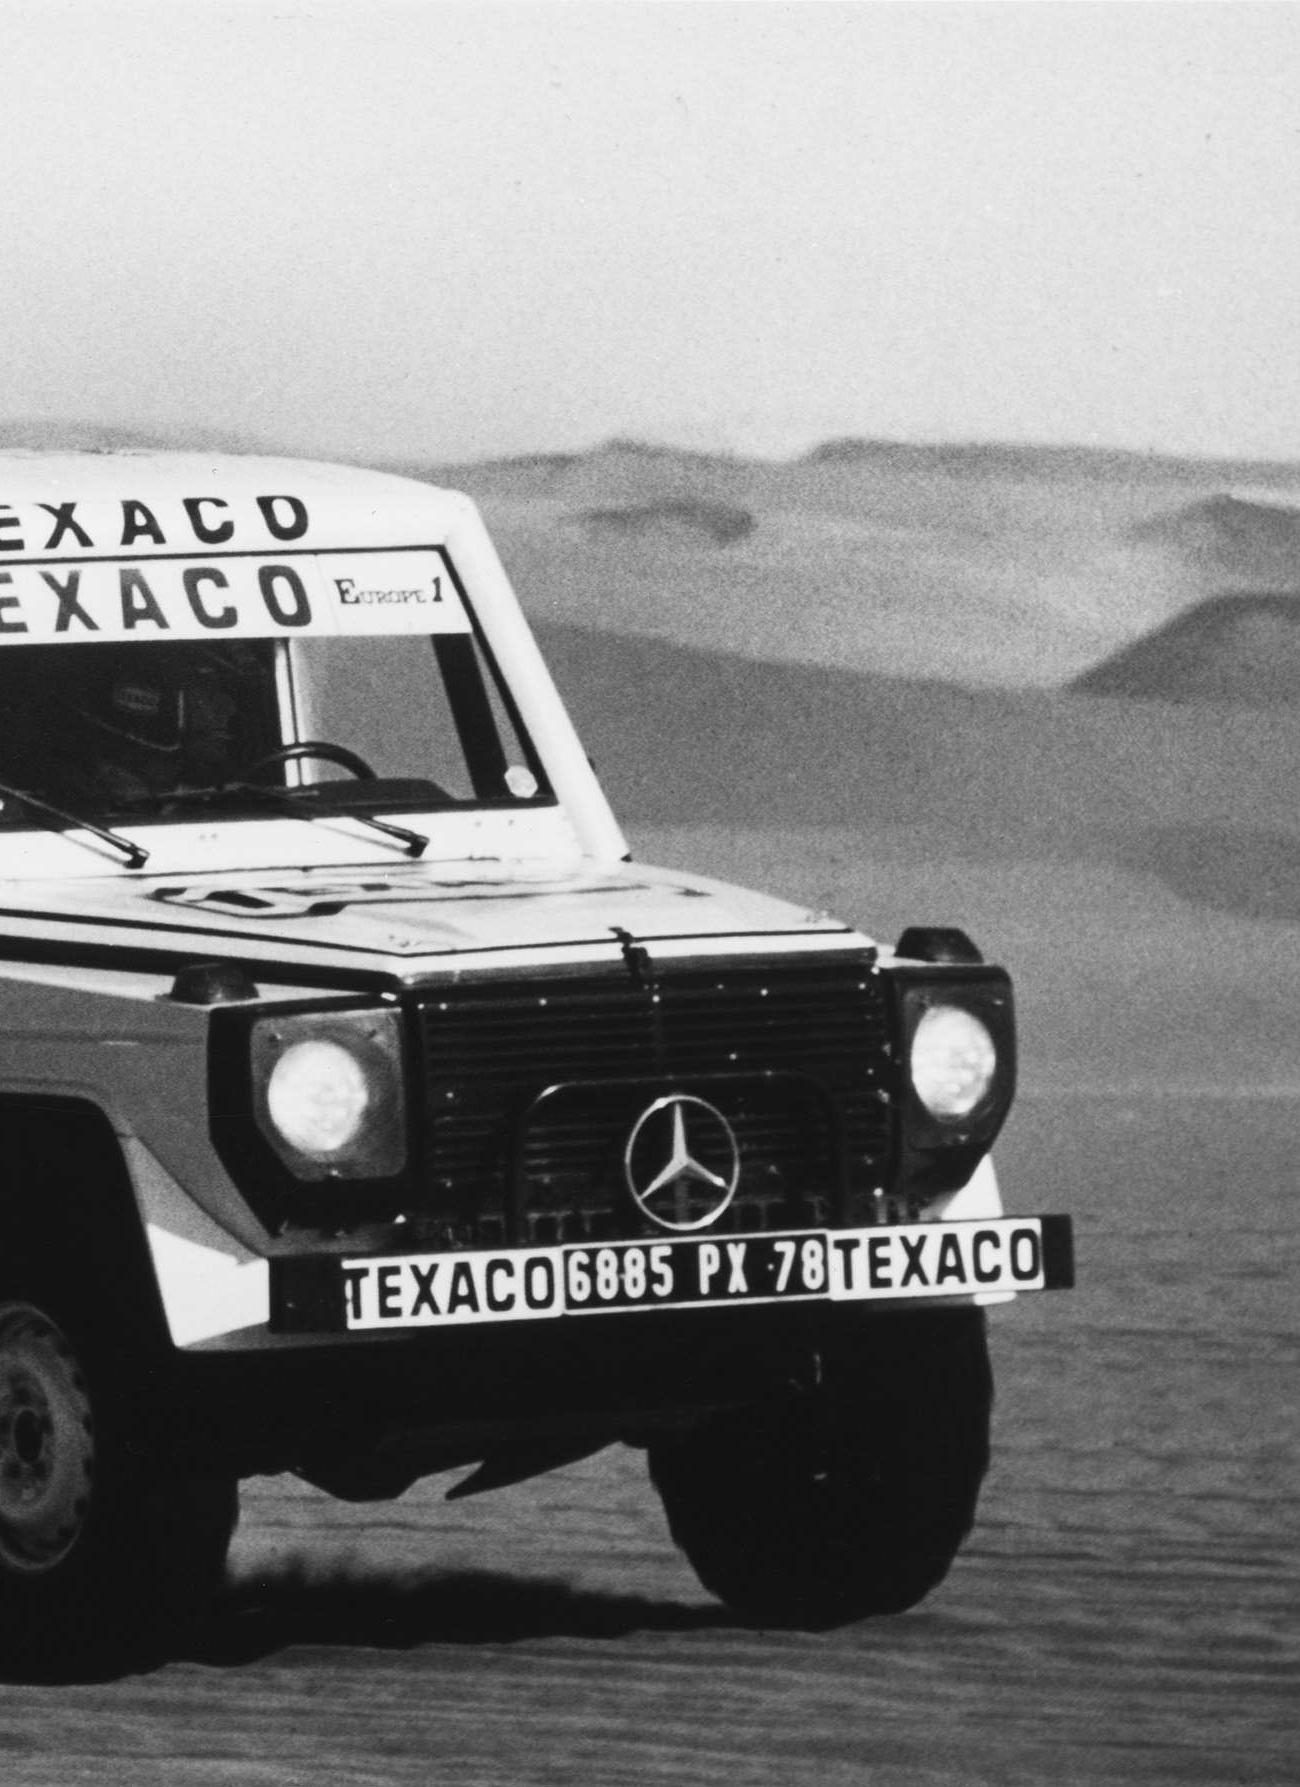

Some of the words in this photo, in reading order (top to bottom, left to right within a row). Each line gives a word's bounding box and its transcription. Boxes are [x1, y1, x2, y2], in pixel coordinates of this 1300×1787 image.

[347, 1256, 556, 1320] TEXACO
[567, 1245, 674, 1301] 6885
[699, 1242, 748, 1295] PX
[772, 1239, 826, 1292] 78
[832, 1228, 1042, 1290] TEXACO
